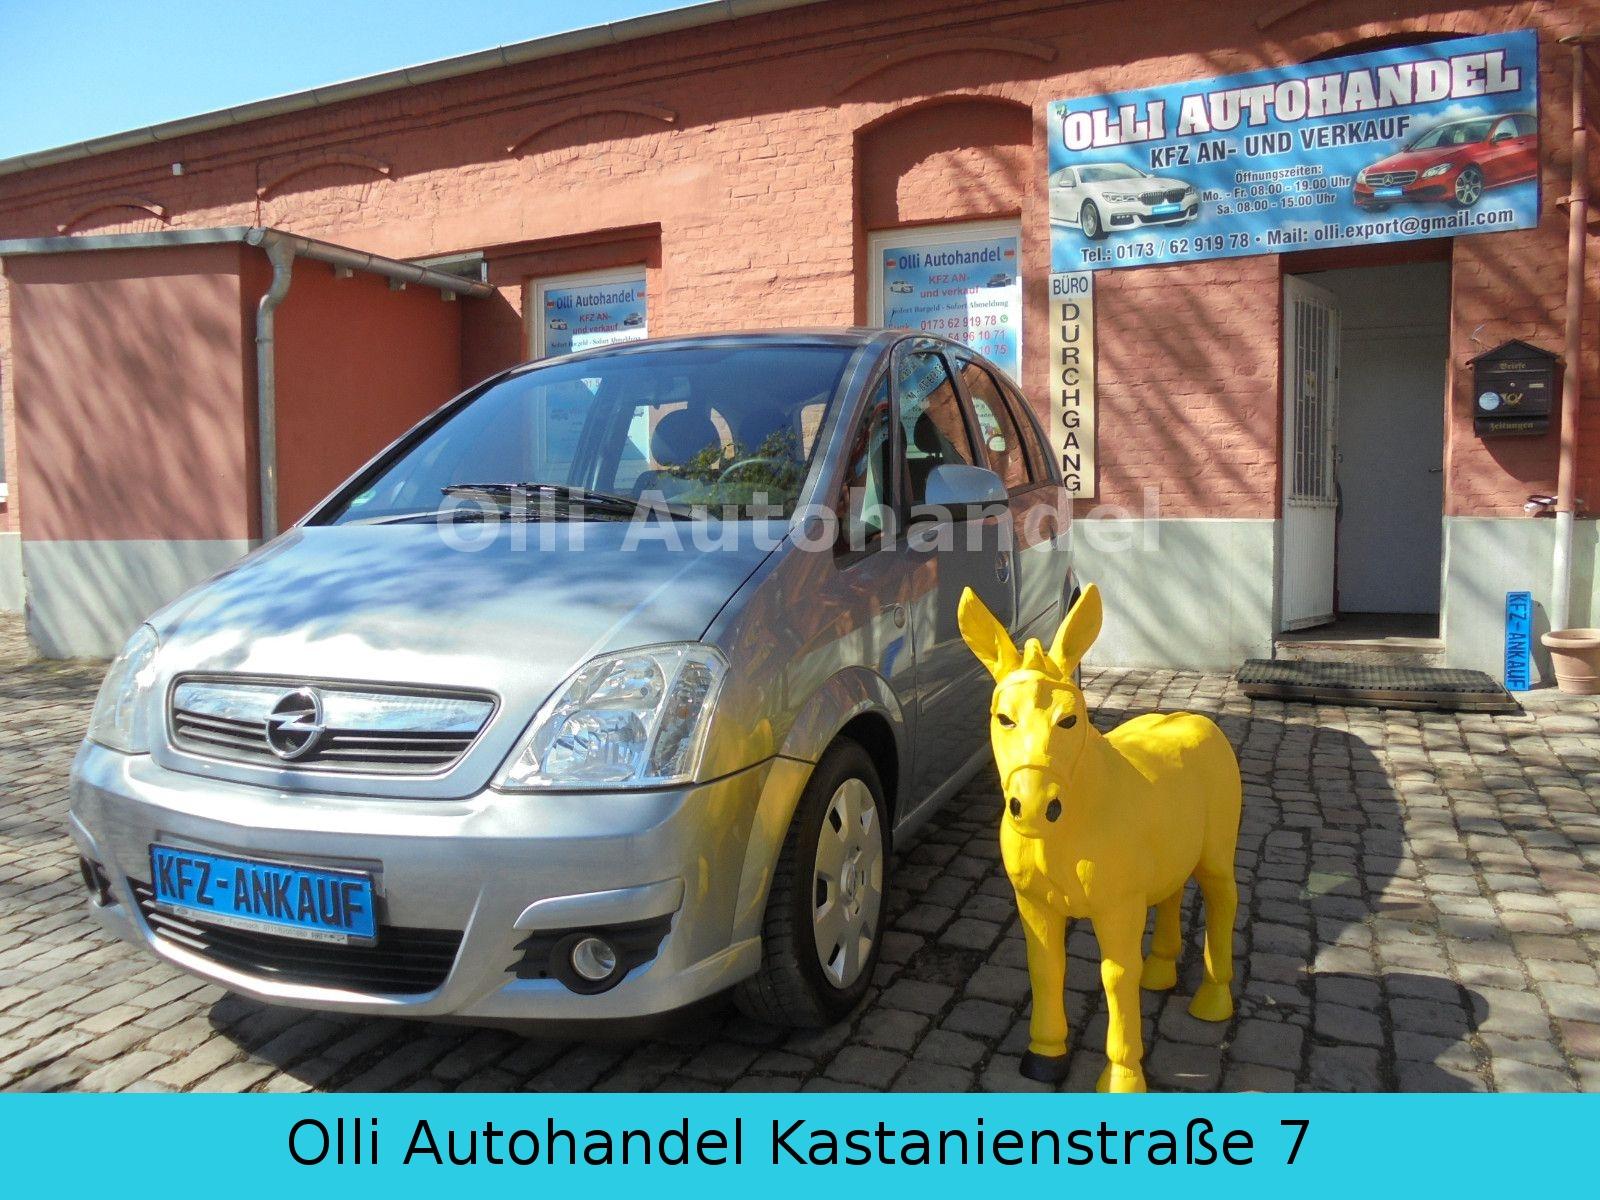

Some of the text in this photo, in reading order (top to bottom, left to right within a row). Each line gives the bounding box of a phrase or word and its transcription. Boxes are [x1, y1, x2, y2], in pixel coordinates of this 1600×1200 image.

[1063, 48, 1522, 151] OLLI AUTOHANDEL
[1151, 115, 1410, 169] KFZ AN- UND VERKAUF
[1235, 164, 1322, 184] Öffnungszeiten:
[1202, 191, 1222, 201] Mo.
[1234, 188, 1247, 198] Fr.
[1250, 184, 1282, 197] 08.00
[1296, 178, 1327, 191] 19.00
[1331, 175, 1351, 187] Uhr
[1217, 204, 1233, 215] Sa.
[1237, 200, 1268, 213] 08.00
[1281, 195, 1312, 208] 15.00
[1316, 193, 1336, 204] Uhr
[1081, 248, 1111, 263] Tel.:
[1116, 244, 1154, 259] 0173
[1170, 239, 1188, 255] 62
[1194, 235, 1224, 251] 919
[1230, 233, 1249, 248] 78
[1267, 227, 1308, 246] Mail:
[1314, 208, 1513, 241] olli.export@gmail.com
[900, 246, 1001, 270] Olli Autohandel
[928, 274, 949, 284] KFZ
[1053, 275, 1089, 295] BÜRO
[556, 288, 635, 310] Olli Autohandel
[920, 285, 979, 298] und verkauf
[920, 318, 944, 331] 0173
[948, 317, 960, 328] 62
[963, 316, 981, 327] 919
[984, 315, 997, 325] 78
[1062, 303, 1081, 492] DURCHGANG
[1508, 593, 1528, 689] KFZ-ANKAUF
[157, 854, 364, 929] KFZ-ANKAUF
